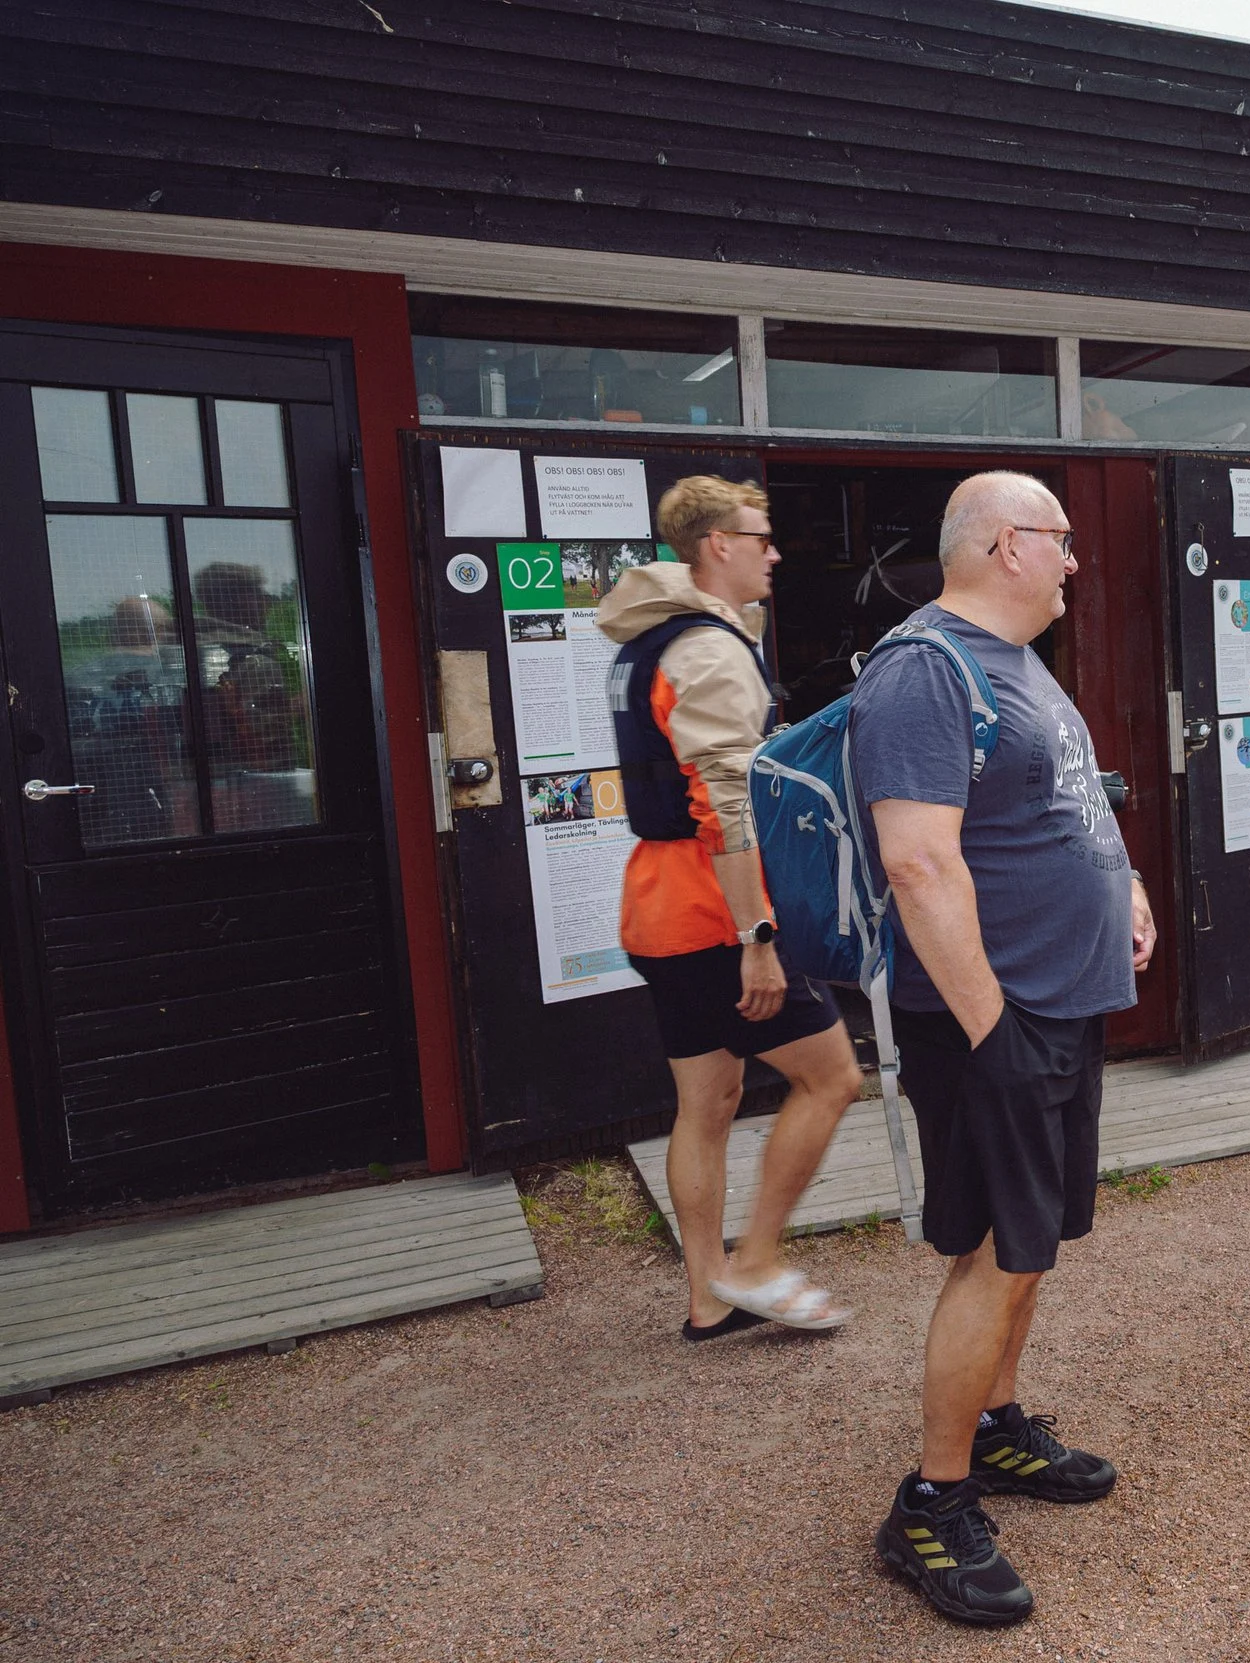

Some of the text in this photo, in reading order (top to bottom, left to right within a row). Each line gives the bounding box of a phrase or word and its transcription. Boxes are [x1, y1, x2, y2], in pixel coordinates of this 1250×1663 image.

[544, 466, 625, 476] OBS! OBS! OBS! OBS!
[508, 557, 556, 589] 02
[572, 610, 601, 618] Månda
[597, 781, 625, 810] 0
[544, 817, 630, 833] Sommarläger, Tävlinga
[545, 830, 597, 841] Ledarskolning
